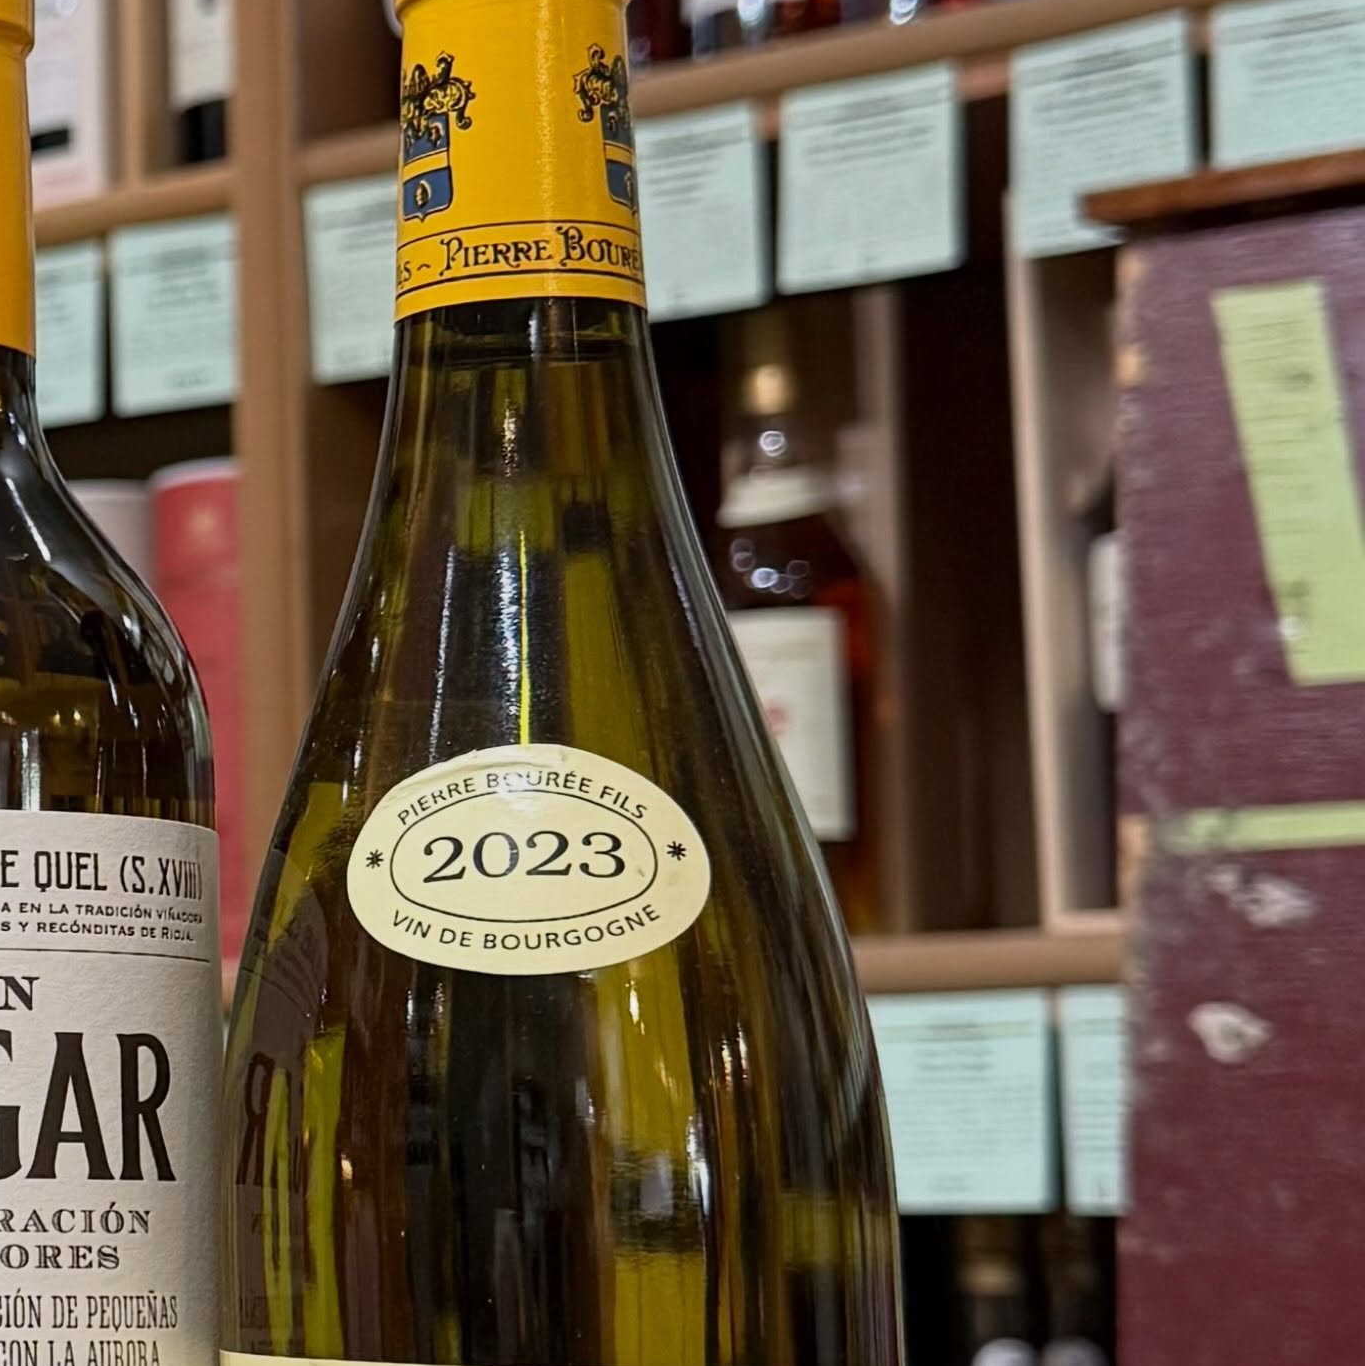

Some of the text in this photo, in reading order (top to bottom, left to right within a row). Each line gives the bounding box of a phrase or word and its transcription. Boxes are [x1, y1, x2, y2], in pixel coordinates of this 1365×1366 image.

[439, 236, 554, 277] PIERRE
[397, 777, 476, 826] PIERRE
[599, 785, 648, 820] FILS
[34, 850, 107, 893] QUEL
[422, 830, 626, 883] 2023
[18, 922, 29, 933] Y
[37, 920, 135, 937] RECÓNDITAS
[19, 902, 41, 913] EN
[49, 903, 69, 915] LA
[392, 903, 661, 951] VIN DE BOURGOGNE
[51, 1295, 79, 1329] DE
[86, 1289, 178, 1333] PEQUEÑAS
